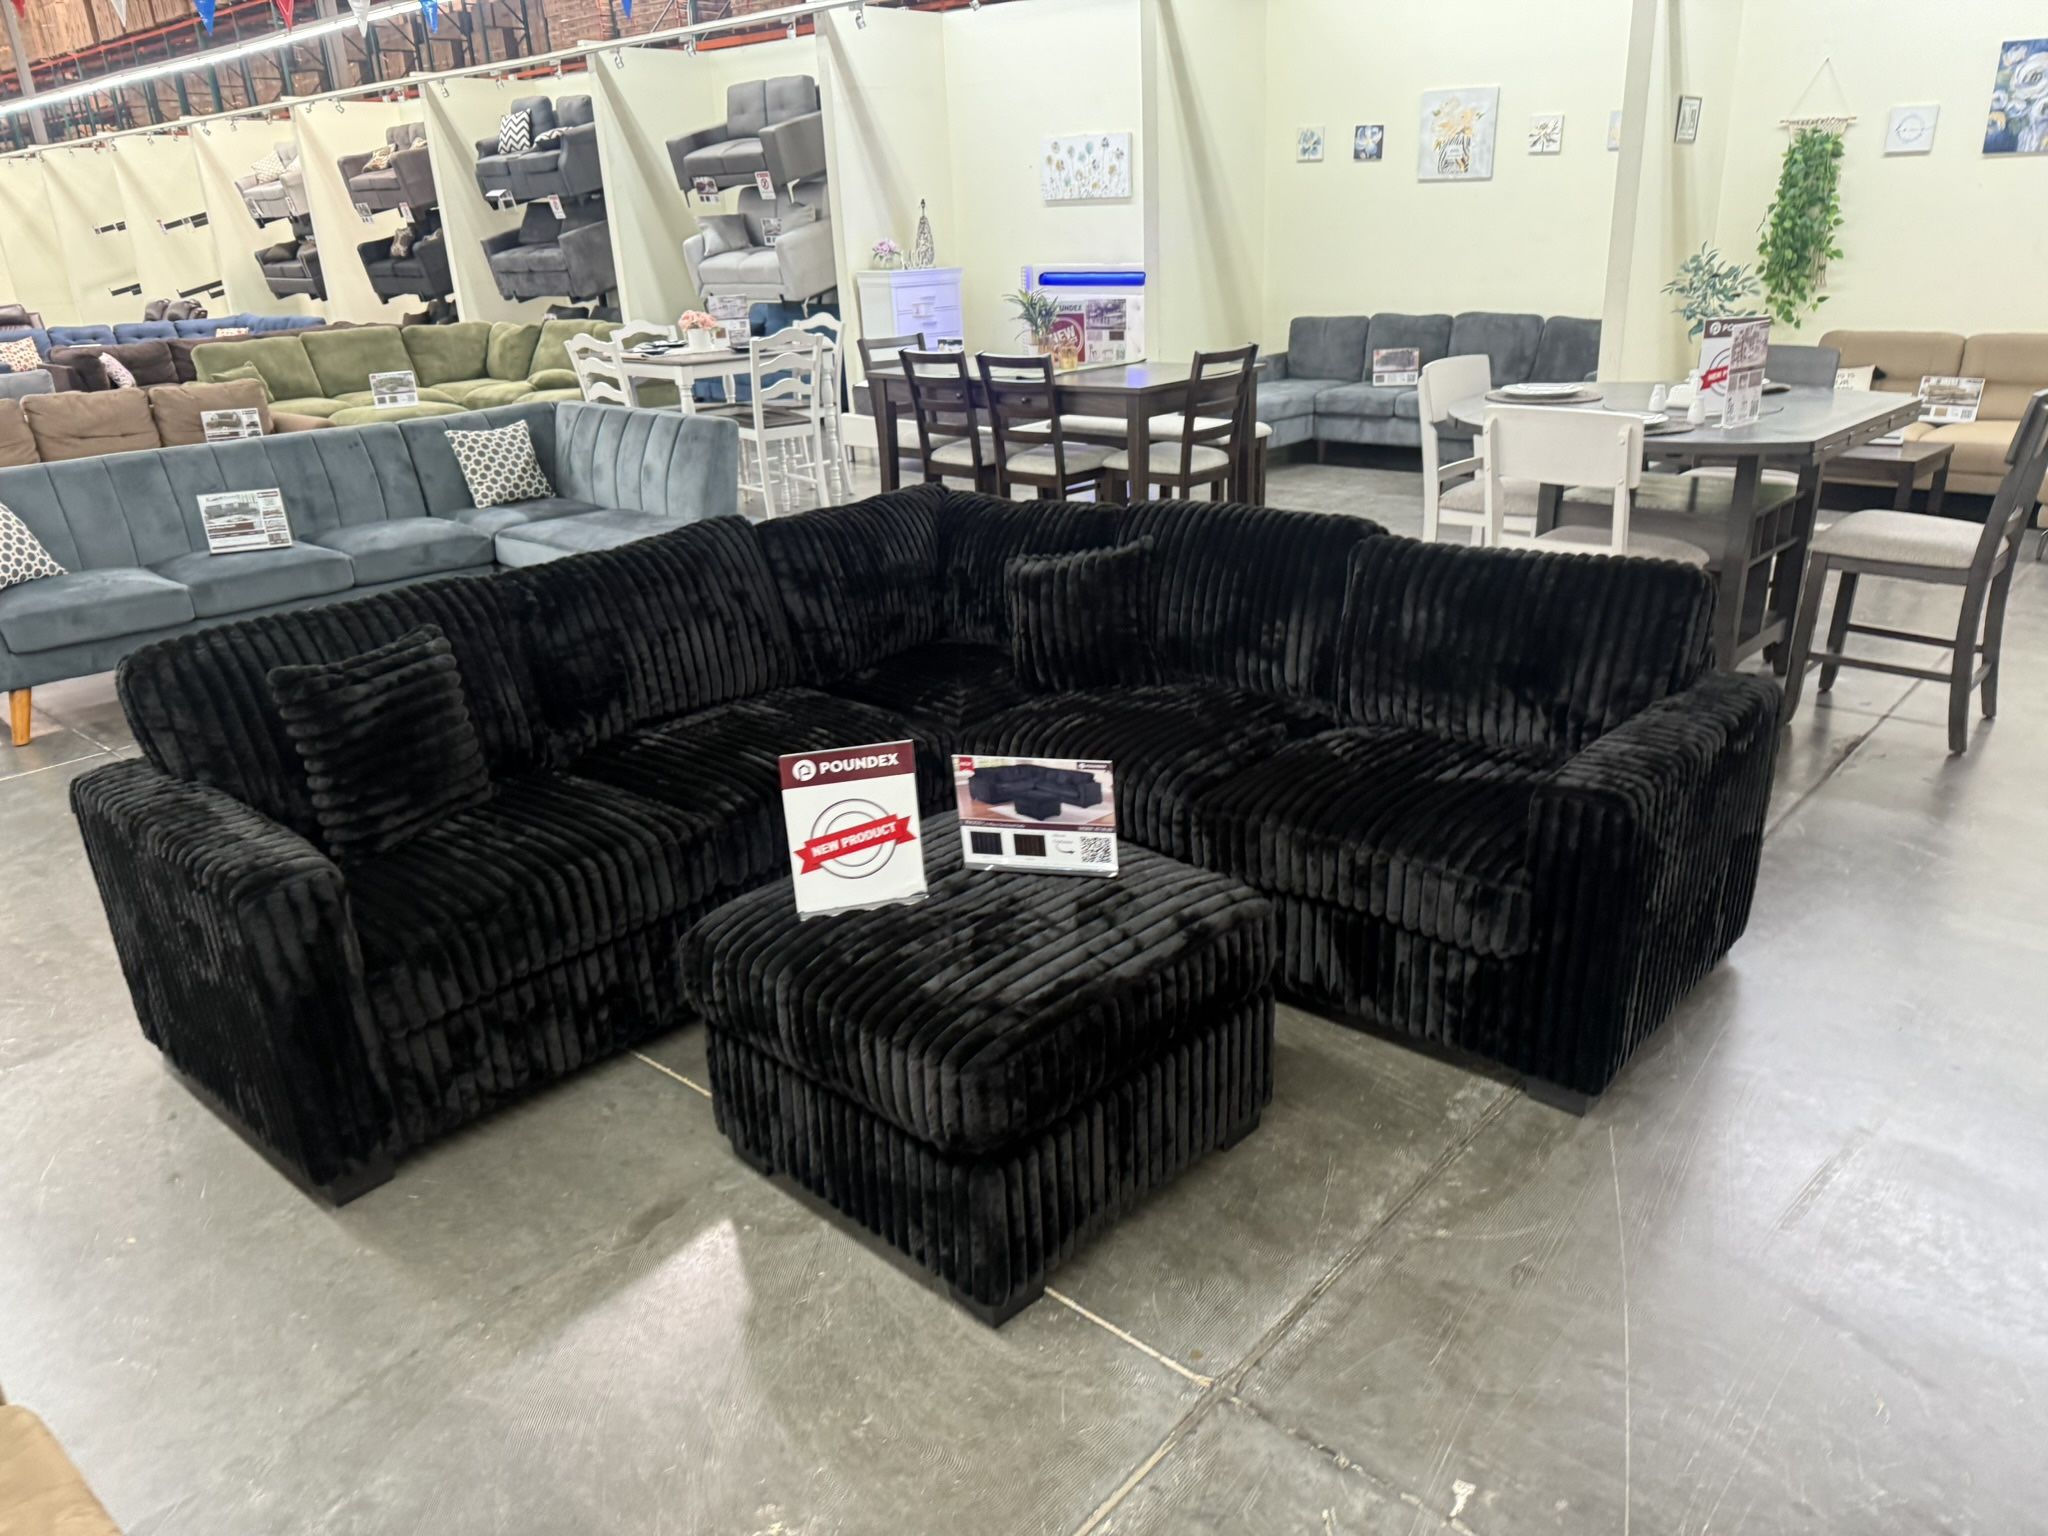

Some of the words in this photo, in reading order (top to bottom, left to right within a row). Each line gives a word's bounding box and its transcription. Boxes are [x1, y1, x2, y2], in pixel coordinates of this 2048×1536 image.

[1059, 303, 1082, 312] UNDEX
[819, 752, 900, 775] POUNDEX
[810, 839, 840, 858] NEW
[841, 821, 898, 848] PRODUCT
